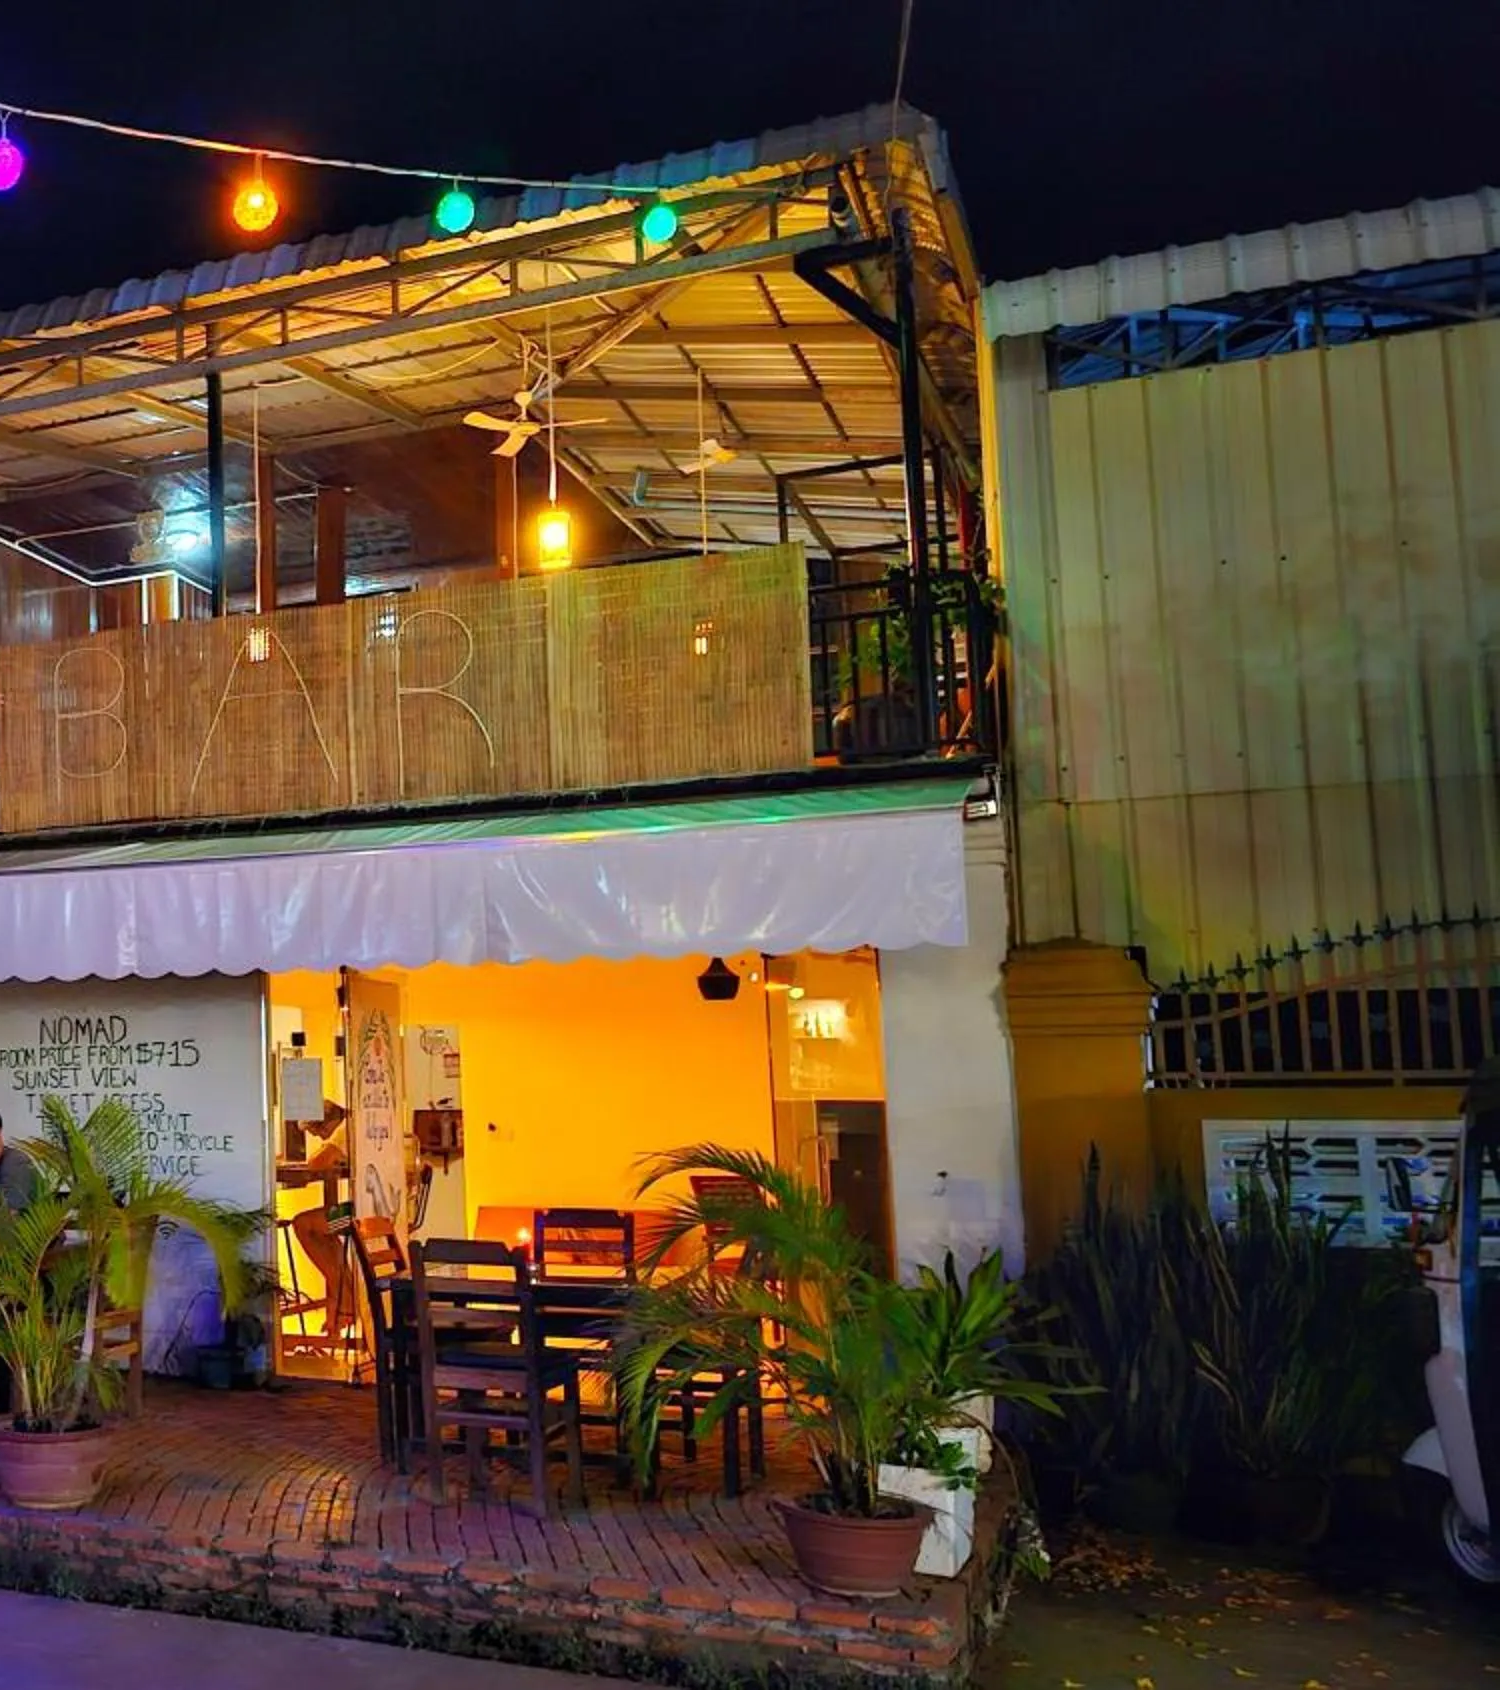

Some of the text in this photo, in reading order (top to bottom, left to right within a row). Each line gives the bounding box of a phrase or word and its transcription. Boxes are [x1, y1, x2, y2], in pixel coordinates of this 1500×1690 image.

[53, 608, 495, 800] BAR
[40, 1015, 128, 1045] NOMAD
[0, 1048, 37, 1068] ROOM
[40, 1046, 81, 1066] PRICE
[87, 1045, 133, 1066] FROM
[12, 1067, 138, 1090] SUNSET VIEW
[25, 1092, 95, 1114] TET
[174, 1132, 234, 1152] BICYCLE
[131, 1154, 204, 1177] ERVICE
